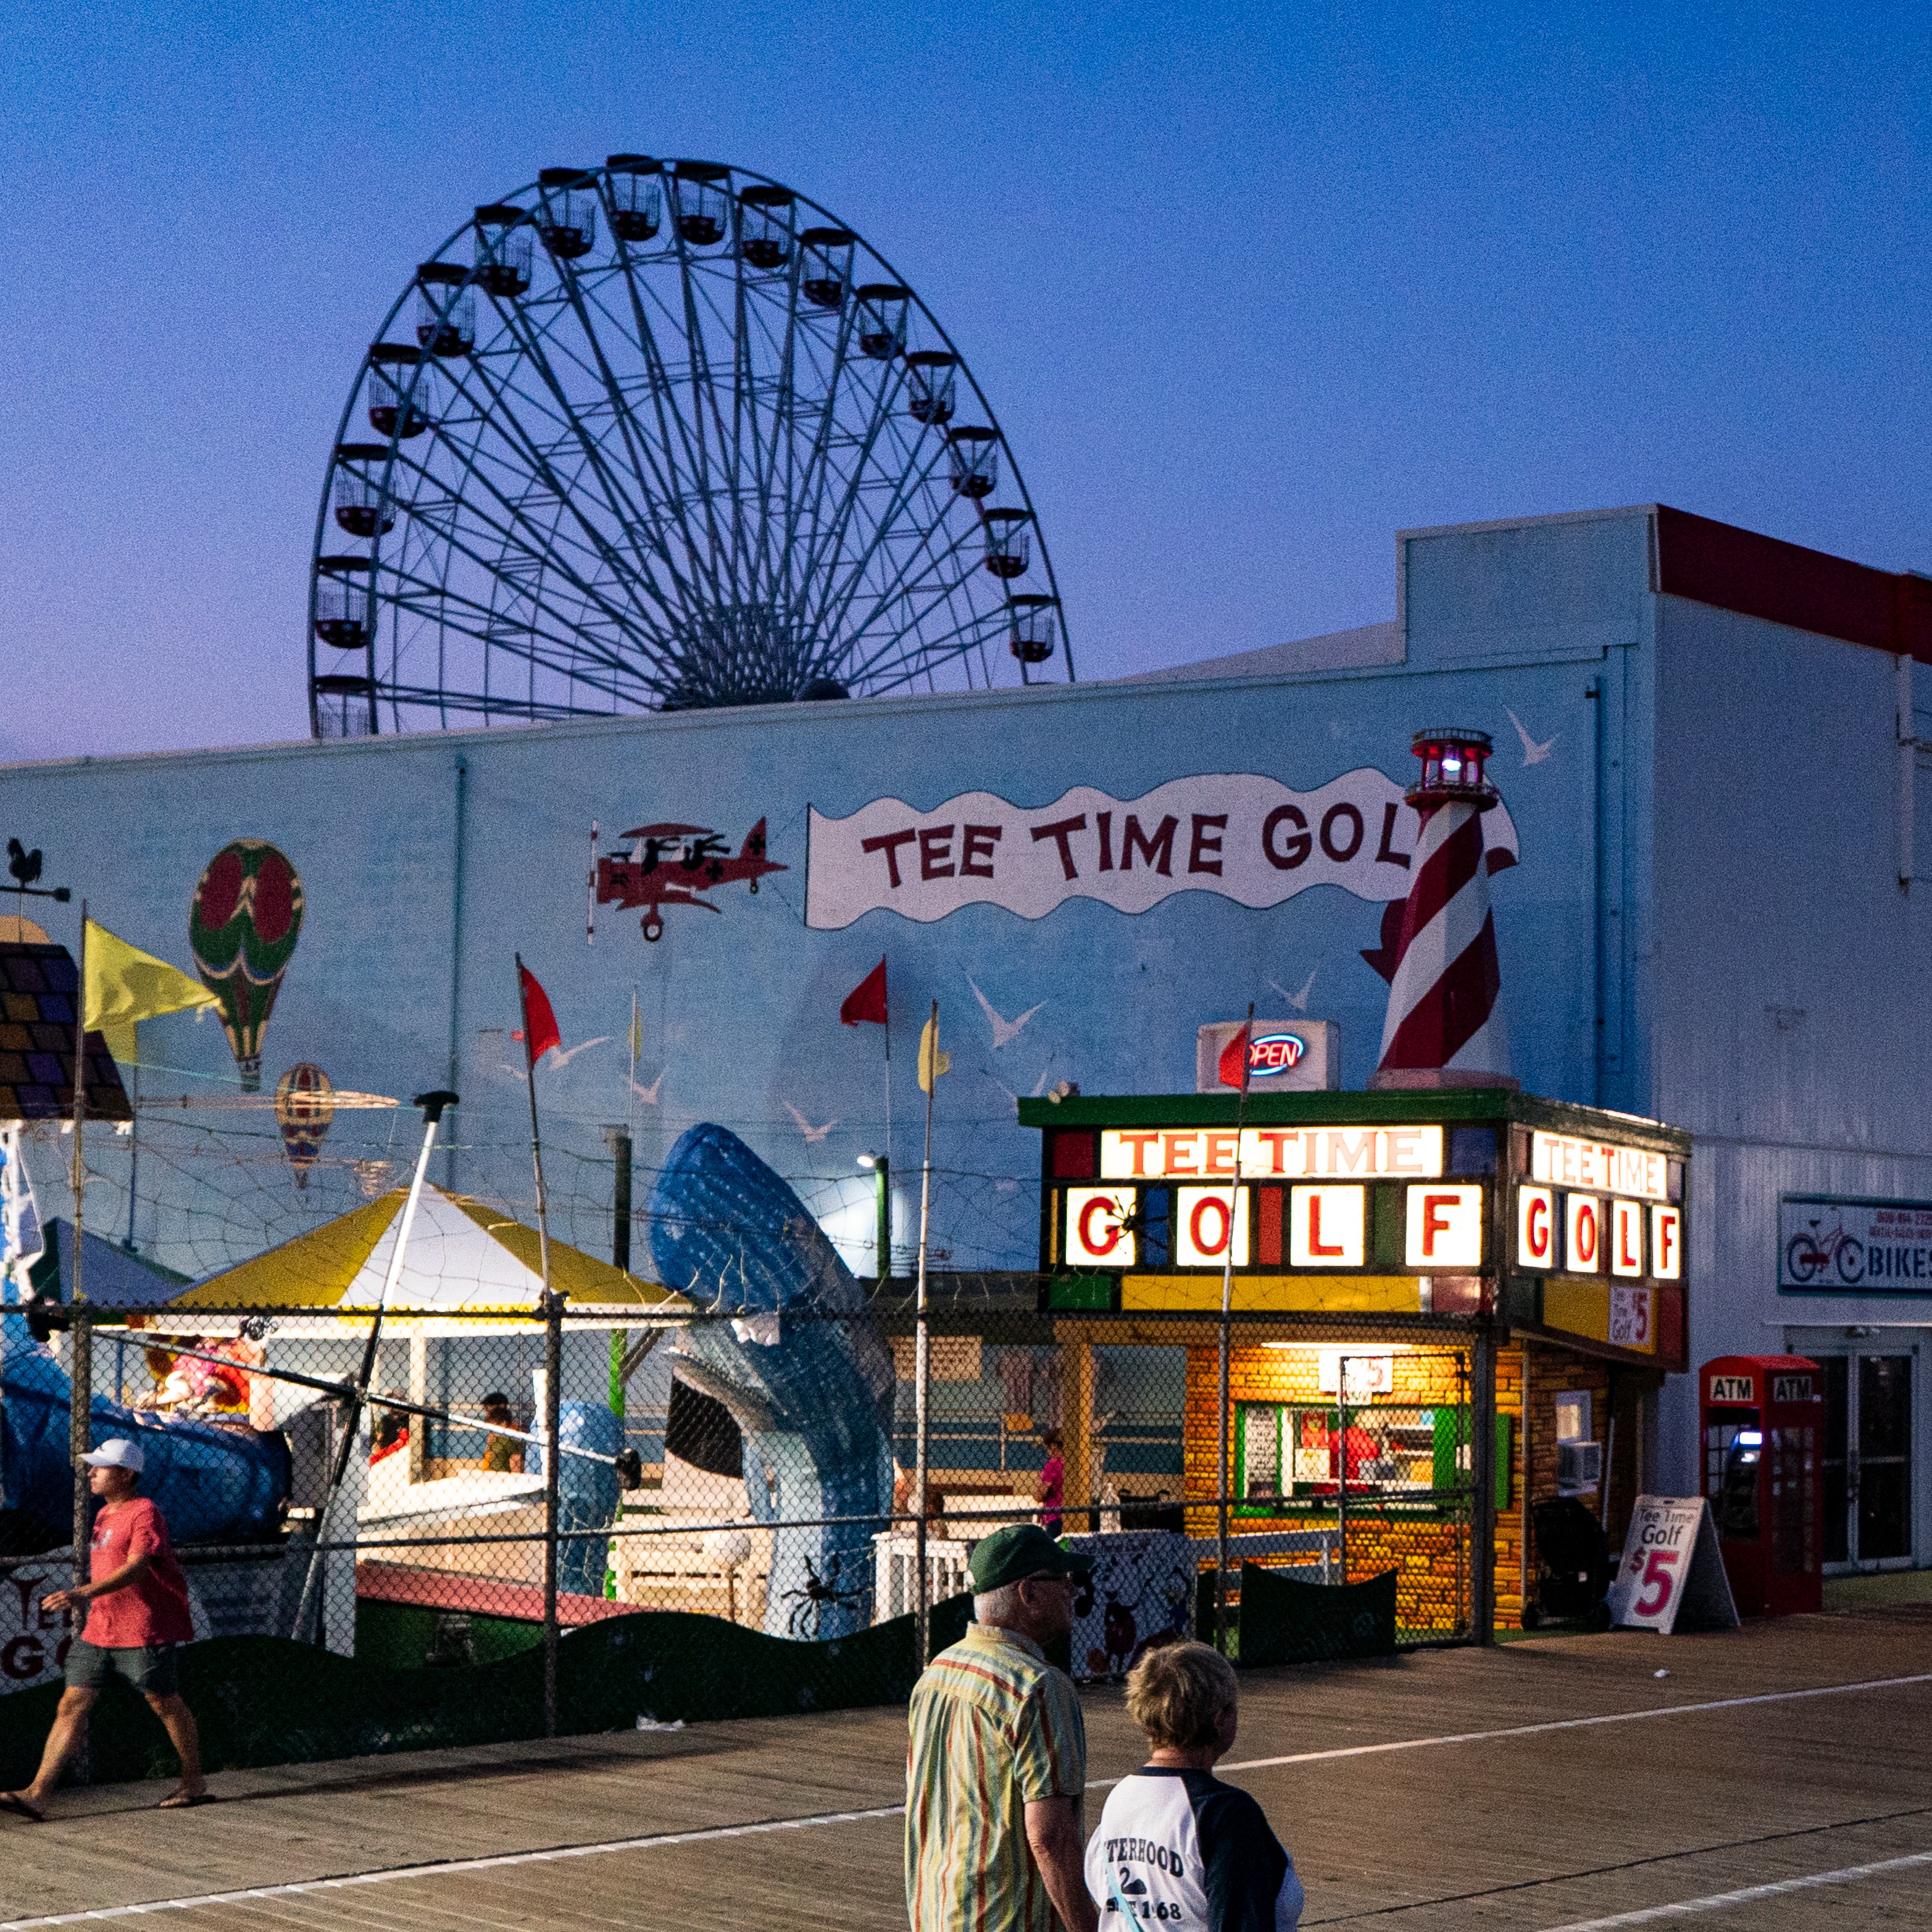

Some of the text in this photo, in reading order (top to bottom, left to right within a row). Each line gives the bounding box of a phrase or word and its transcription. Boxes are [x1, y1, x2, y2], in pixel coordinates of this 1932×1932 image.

[861, 802, 1412, 888] TEE TIME GOL
[1120, 1131, 1423, 1175] TEE TIME
[1544, 1138, 1658, 1194] TEE TIME
[1078, 1195, 1461, 1257] GOLF
[1526, 1197, 1676, 1270] GOLF
[1713, 1378, 1751, 1399] ATM
[1776, 1378, 1810, 1399] ATM
[1639, 1507, 1694, 1523] Tee Time
[1641, 1524, 1683, 1546] Golf
[1630, 1546, 1680, 1617] $5
[1104, 1838, 1183, 1878] TERHOOD
[1142, 1900, 1182, 1920] 168
